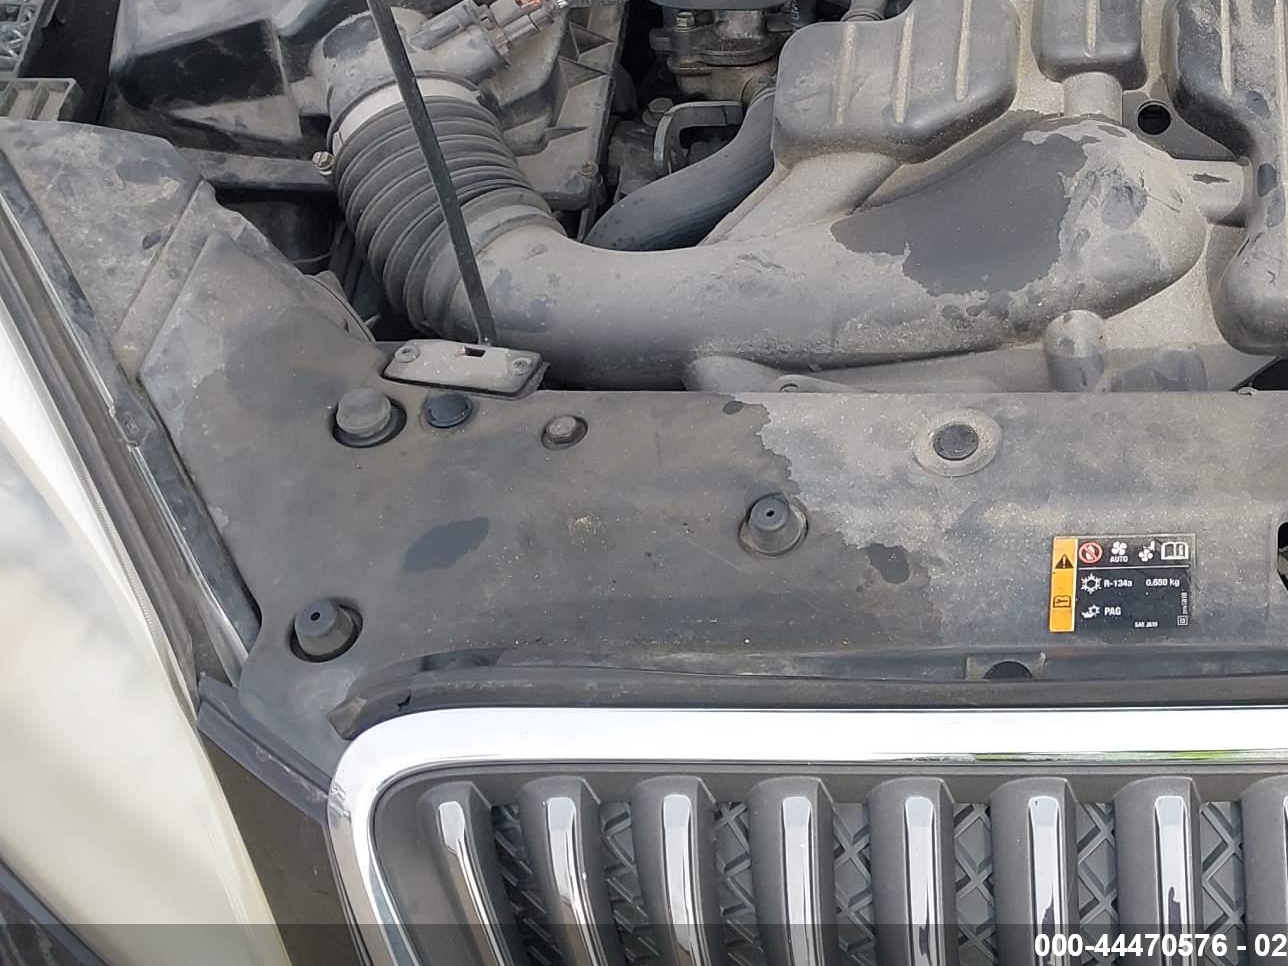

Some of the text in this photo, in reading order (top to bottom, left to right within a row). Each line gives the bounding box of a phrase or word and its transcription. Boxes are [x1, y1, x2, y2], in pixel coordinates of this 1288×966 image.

[1109, 555, 1129, 563] AUTO
[1103, 579, 1133, 588] R-134a
[1169, 577, 1180, 588] kg
[1104, 606, 1122, 616] PAG
